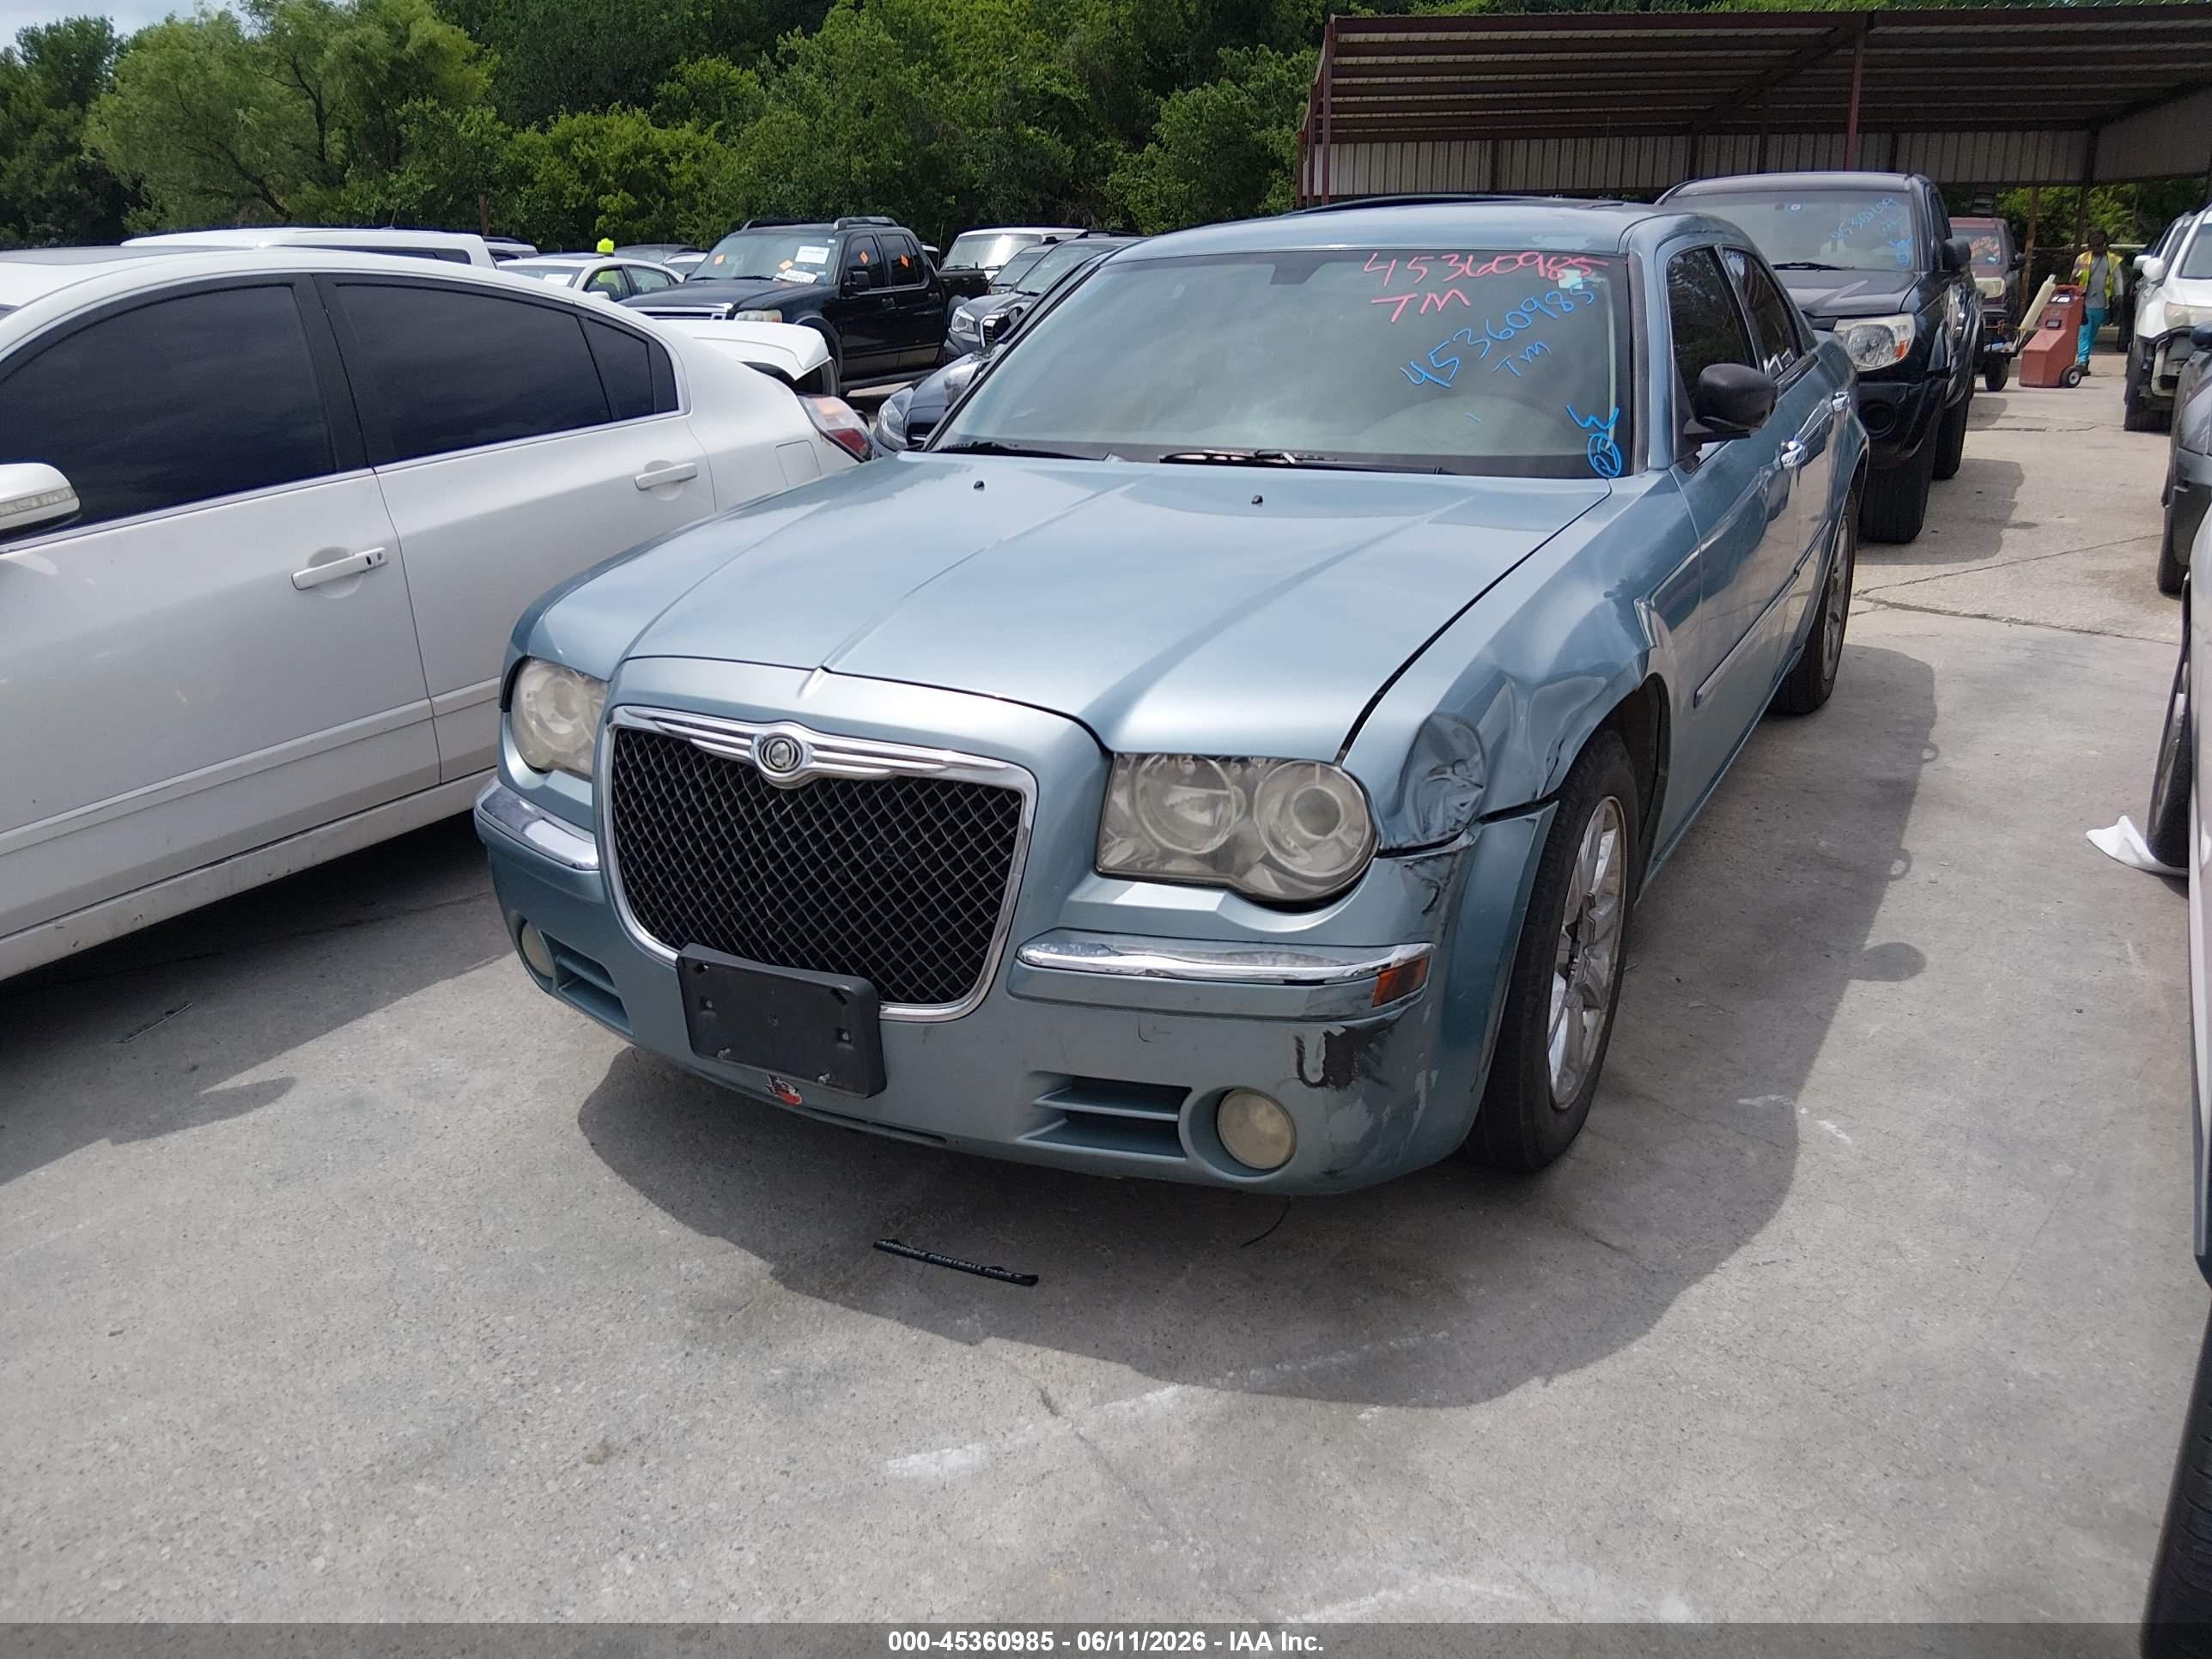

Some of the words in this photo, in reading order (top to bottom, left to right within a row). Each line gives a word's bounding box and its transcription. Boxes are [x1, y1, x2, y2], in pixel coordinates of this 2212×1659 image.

[1364, 251, 1608, 288] 45360985
[1370, 289, 1471, 323] TM
[1400, 279, 1595, 387] 45360985
